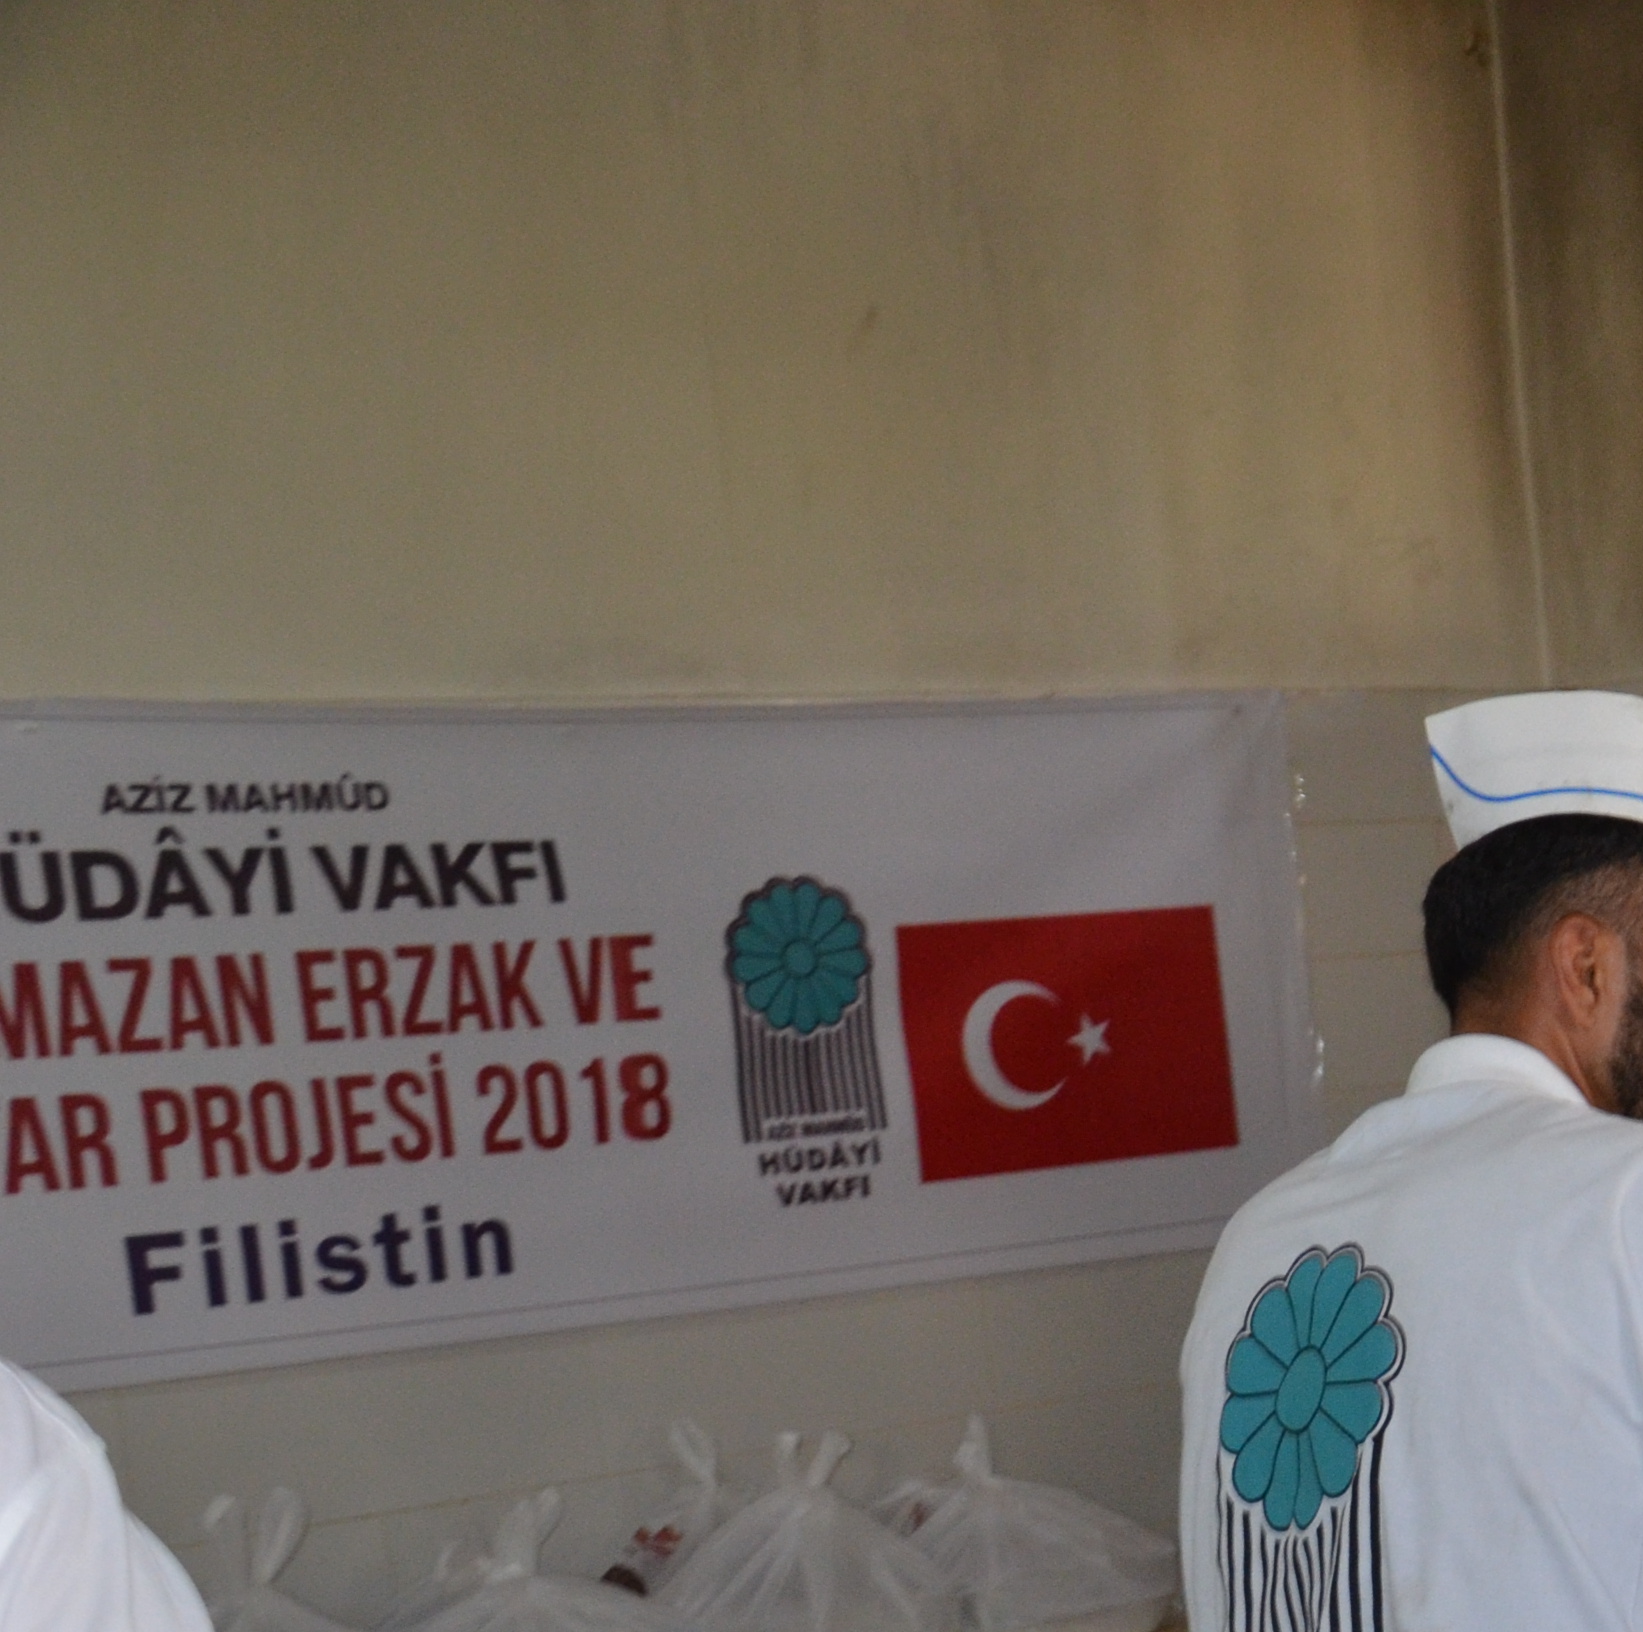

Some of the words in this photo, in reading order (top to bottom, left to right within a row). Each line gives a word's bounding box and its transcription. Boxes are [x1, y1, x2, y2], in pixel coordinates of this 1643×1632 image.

[100, 774, 196, 815] AZİZ
[307, 838, 567, 913] VAKFI
[295, 940, 547, 1043] ERZAK
[560, 933, 662, 1028] VE
[139, 1052, 456, 1184] PROJESİ
[477, 1052, 673, 1155] 2018
[123, 1204, 516, 1317] Filistin
